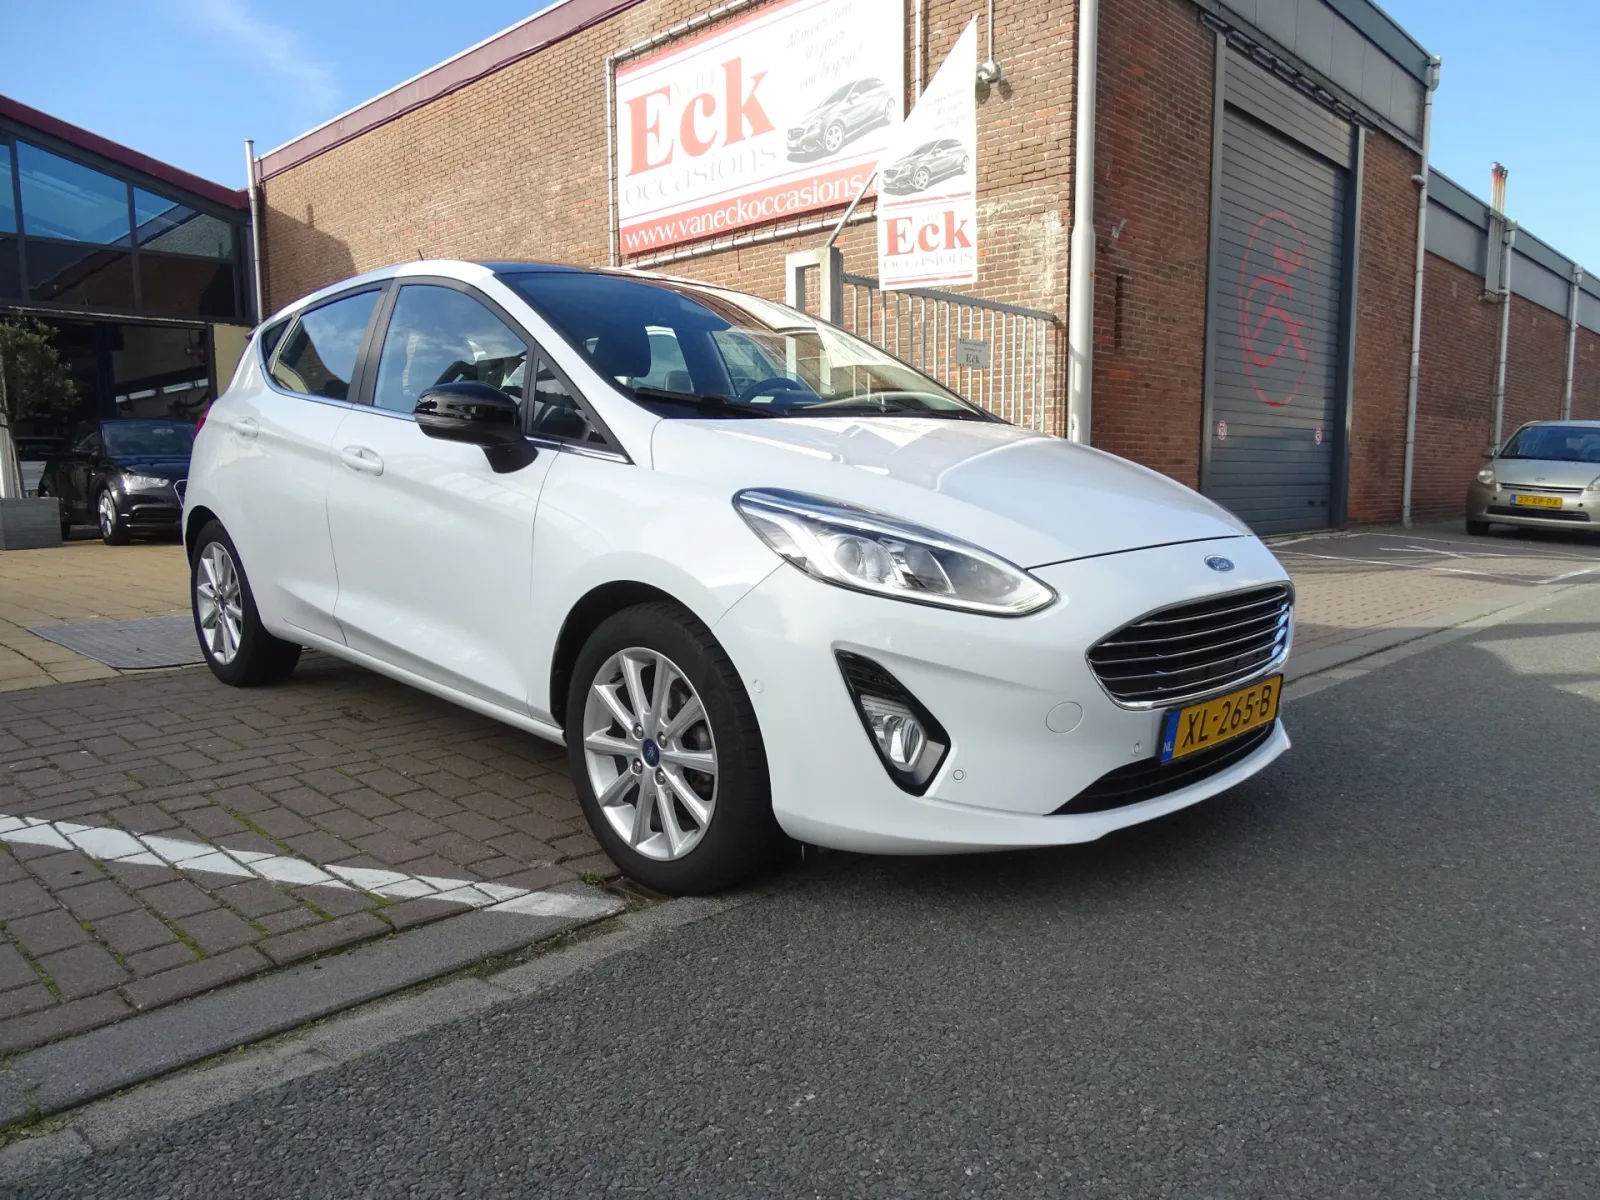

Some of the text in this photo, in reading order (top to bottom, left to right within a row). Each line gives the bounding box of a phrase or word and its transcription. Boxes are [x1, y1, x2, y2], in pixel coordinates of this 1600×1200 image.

[624, 57, 777, 177] Eck
[884, 210, 973, 257] Eck
[1182, 685, 1272, 749] XL-265-B
[1163, 741, 1172, 753] NL
